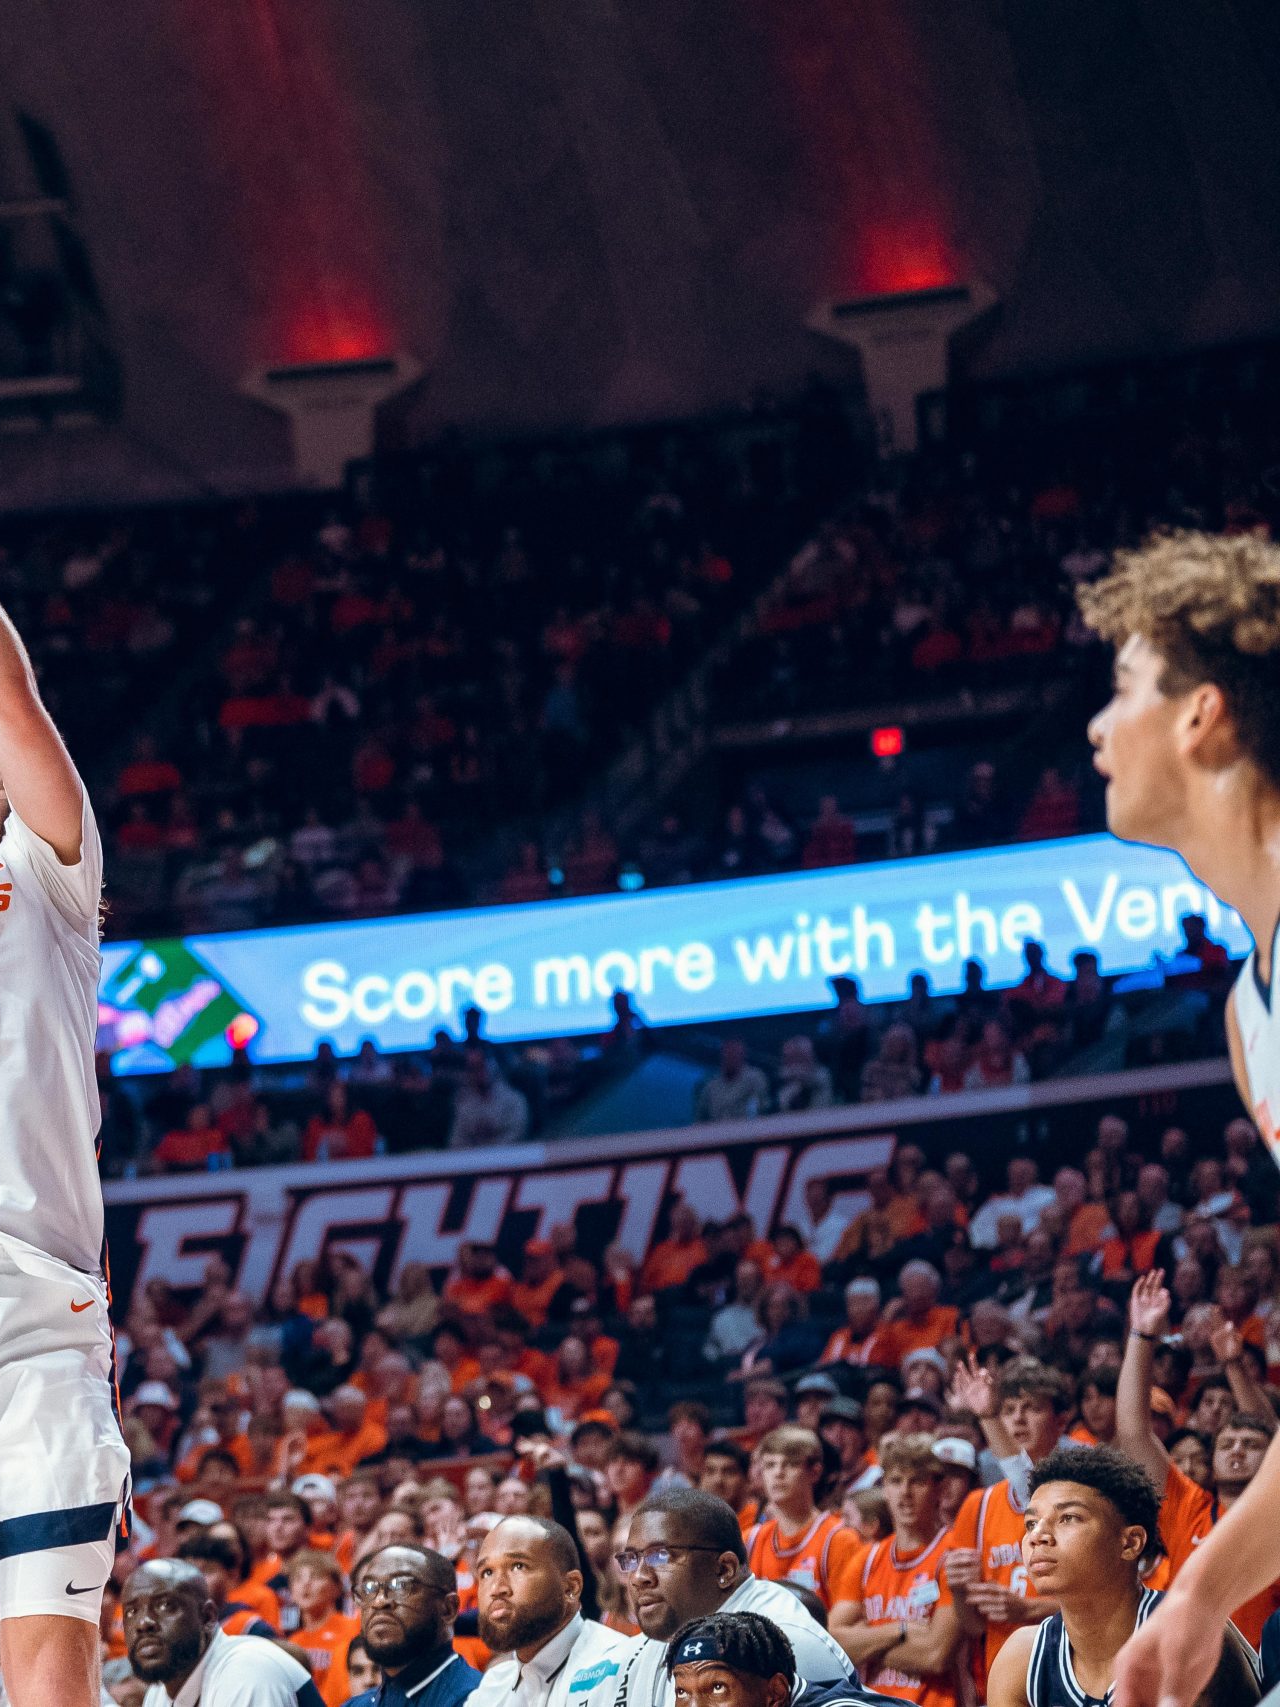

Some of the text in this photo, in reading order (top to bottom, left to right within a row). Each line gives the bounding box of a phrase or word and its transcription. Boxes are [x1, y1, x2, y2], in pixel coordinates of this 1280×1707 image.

[302, 961, 515, 1028] Score
[533, 942, 716, 1006] more
[734, 903, 896, 982] with
[915, 891, 1043, 963] the
